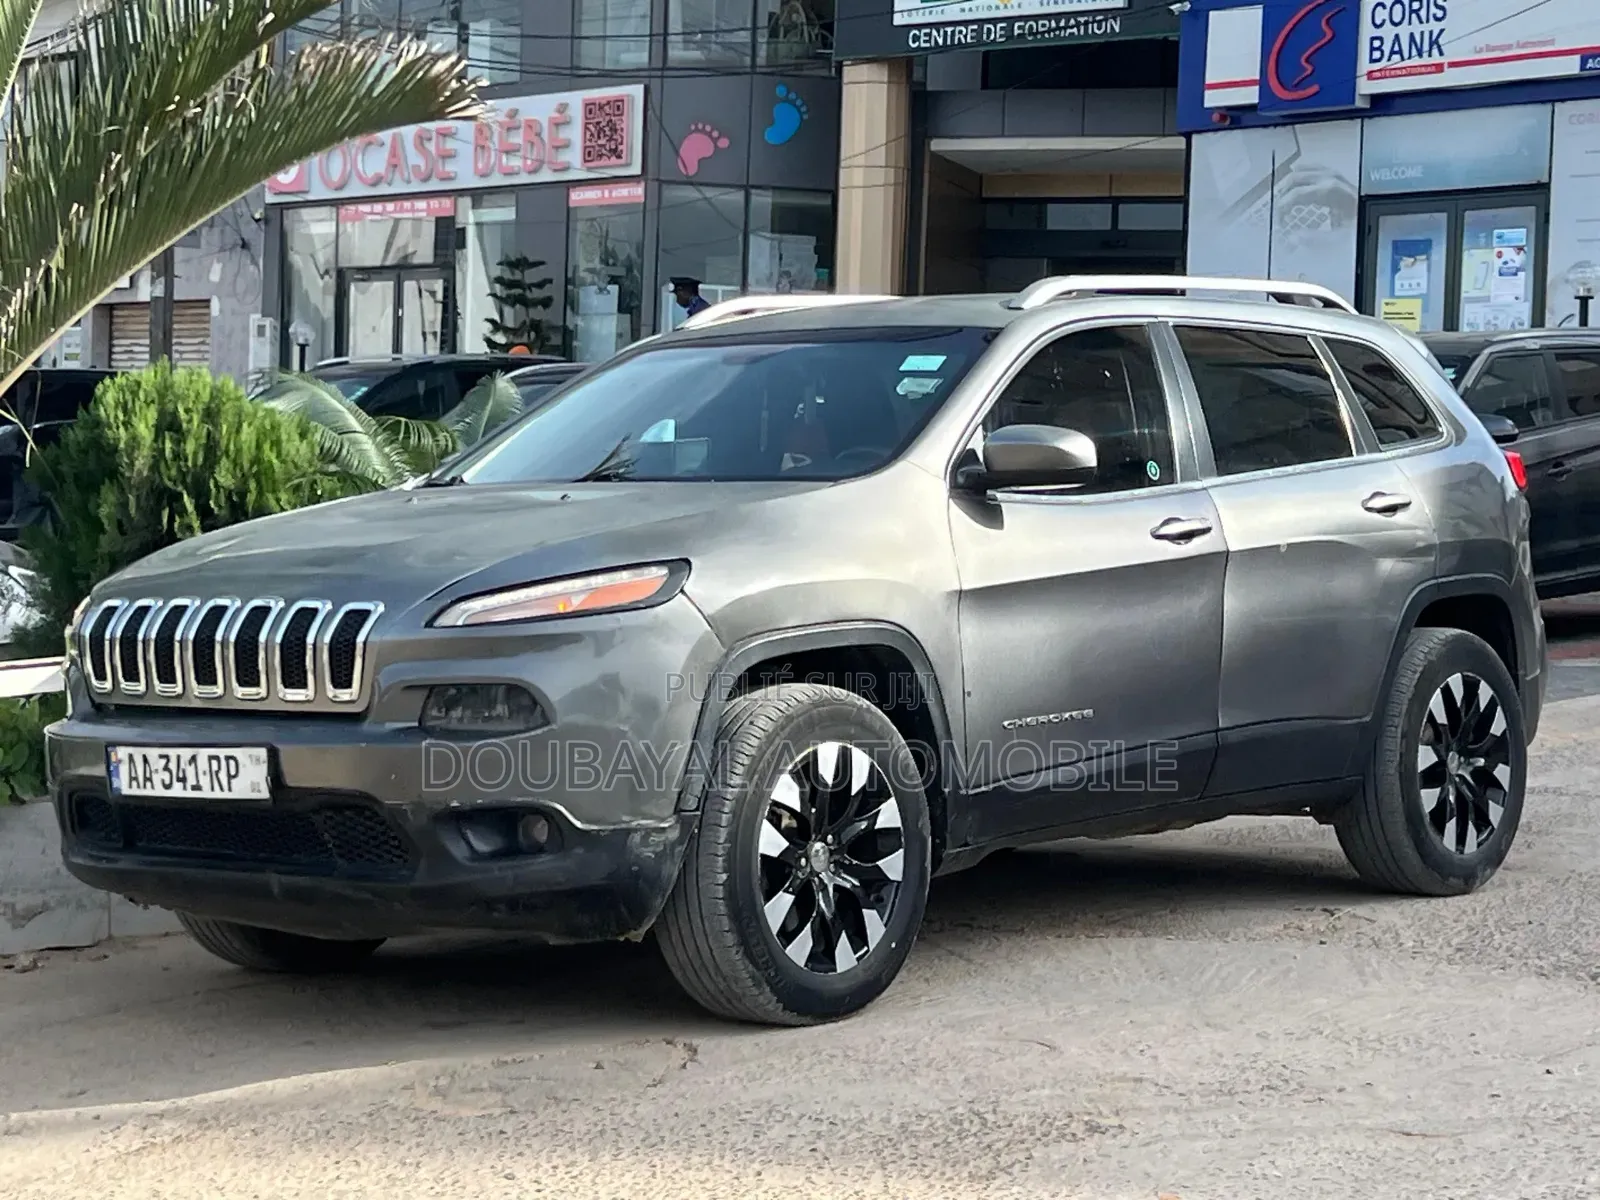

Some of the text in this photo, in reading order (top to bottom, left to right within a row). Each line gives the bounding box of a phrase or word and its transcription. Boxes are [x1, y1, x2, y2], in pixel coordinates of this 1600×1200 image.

[959, 3, 1023, 13] NATIONALE
[1371, 0, 1447, 29] CORIS
[908, 15, 1121, 48] CENTRE DE FORMATION
[1368, 28, 1446, 64] BANK
[317, 102, 572, 191] OCASE BÉBÉ
[1370, 165, 1424, 182] WELCOME
[1002, 708, 1094, 729] CHEROKEE
